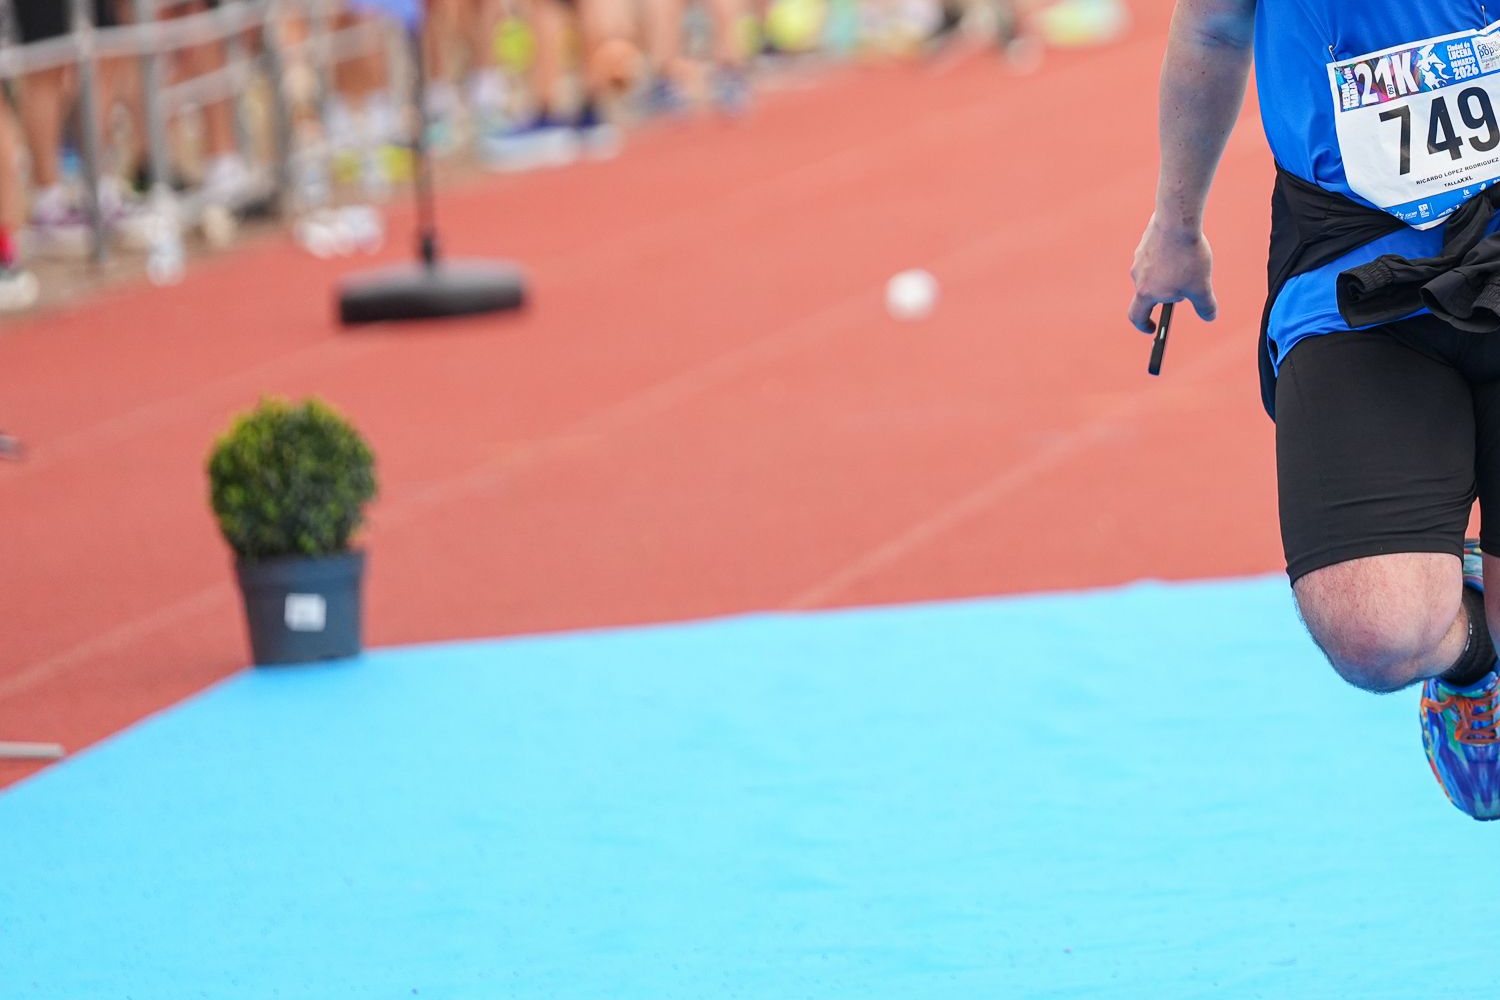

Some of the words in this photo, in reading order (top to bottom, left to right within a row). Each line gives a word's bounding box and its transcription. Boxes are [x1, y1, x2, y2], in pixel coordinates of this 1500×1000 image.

[1448, 48, 1473, 60] LUCENA
[1354, 52, 1420, 105] 21K
[1453, 63, 1479, 80] 2026
[1379, 86, 1500, 176] 749
[1416, 174, 1443, 185] RICARDO
[1464, 157, 1500, 171] RODRIGUEZ
